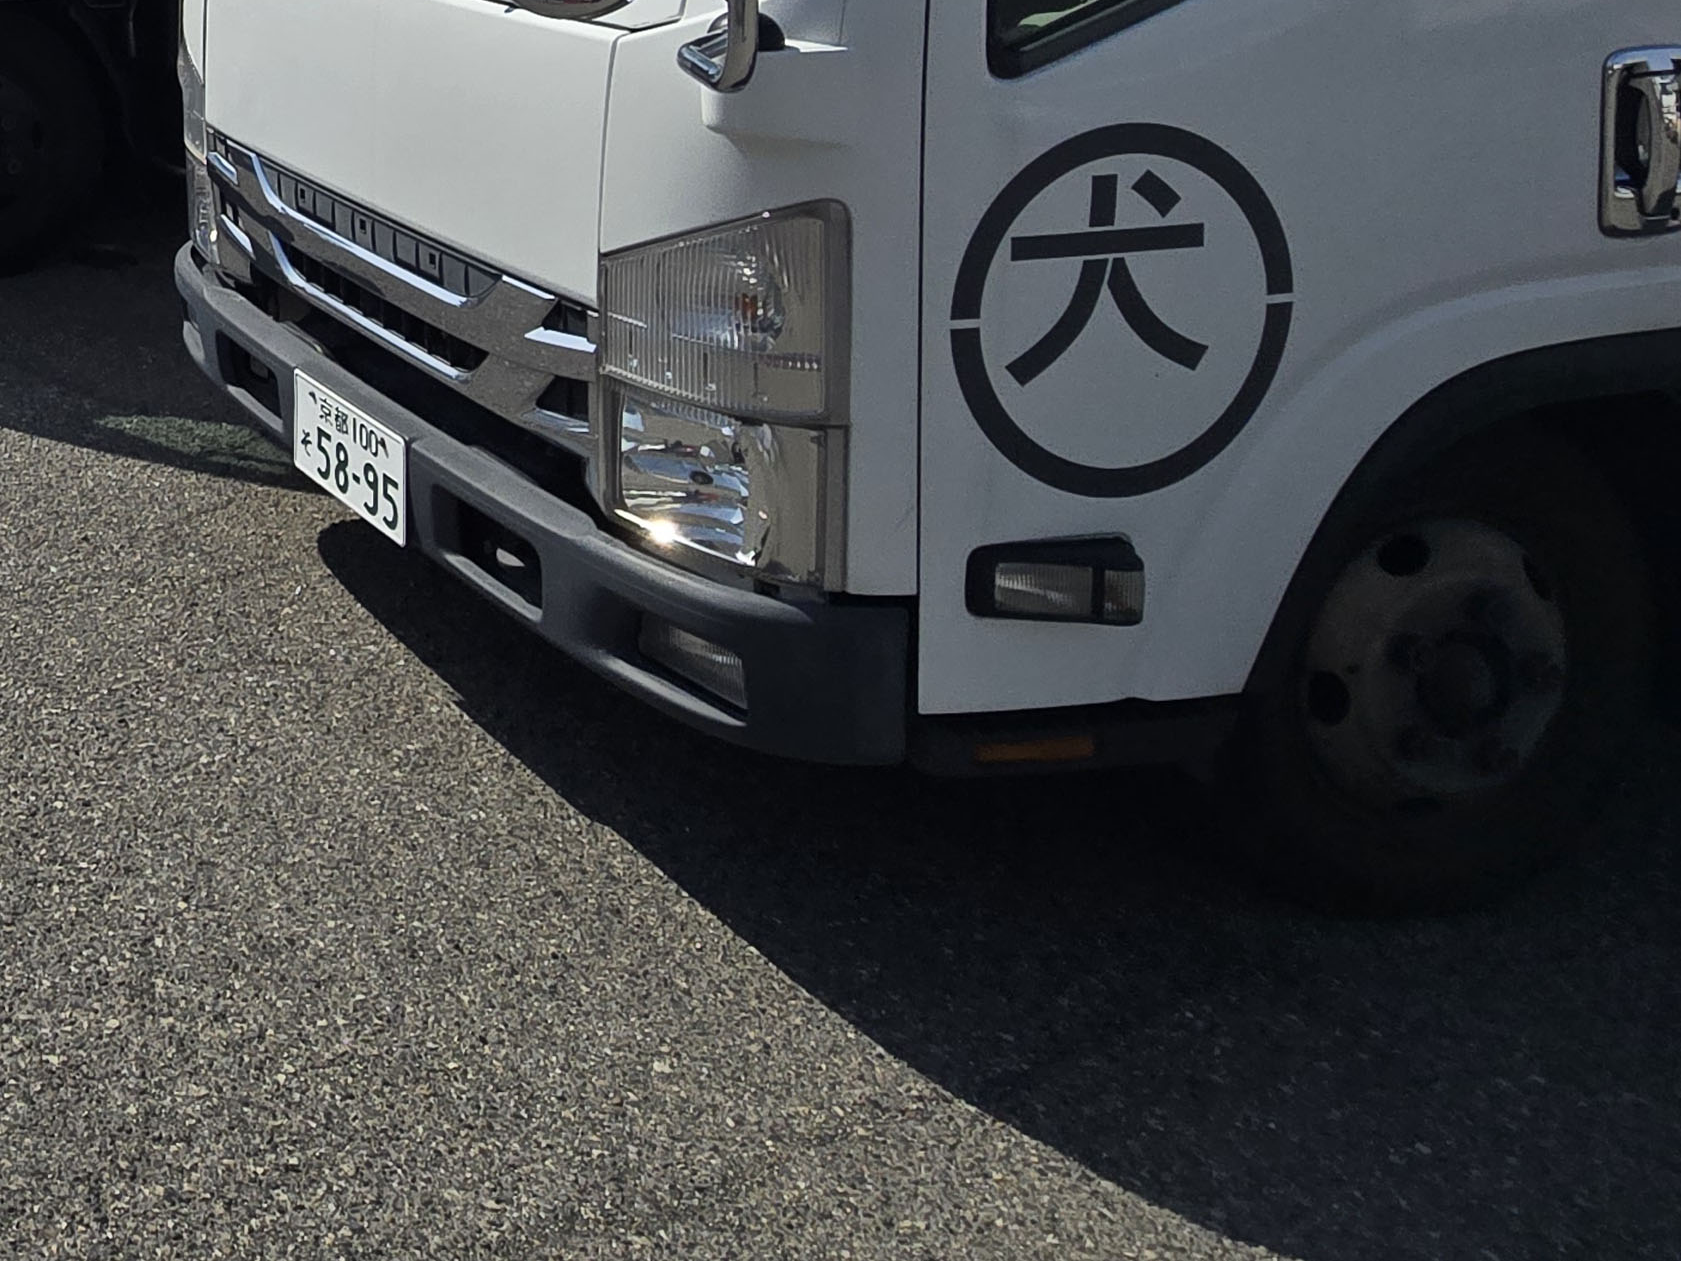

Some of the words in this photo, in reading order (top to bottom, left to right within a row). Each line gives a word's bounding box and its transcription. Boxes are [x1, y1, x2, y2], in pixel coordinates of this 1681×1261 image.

[1005, 169, 1209, 388] 犬
[301, 429, 313, 457] そ
[316, 426, 399, 531] 58-95
[319, 396, 348, 435] 京都
[352, 417, 379, 457] 100
